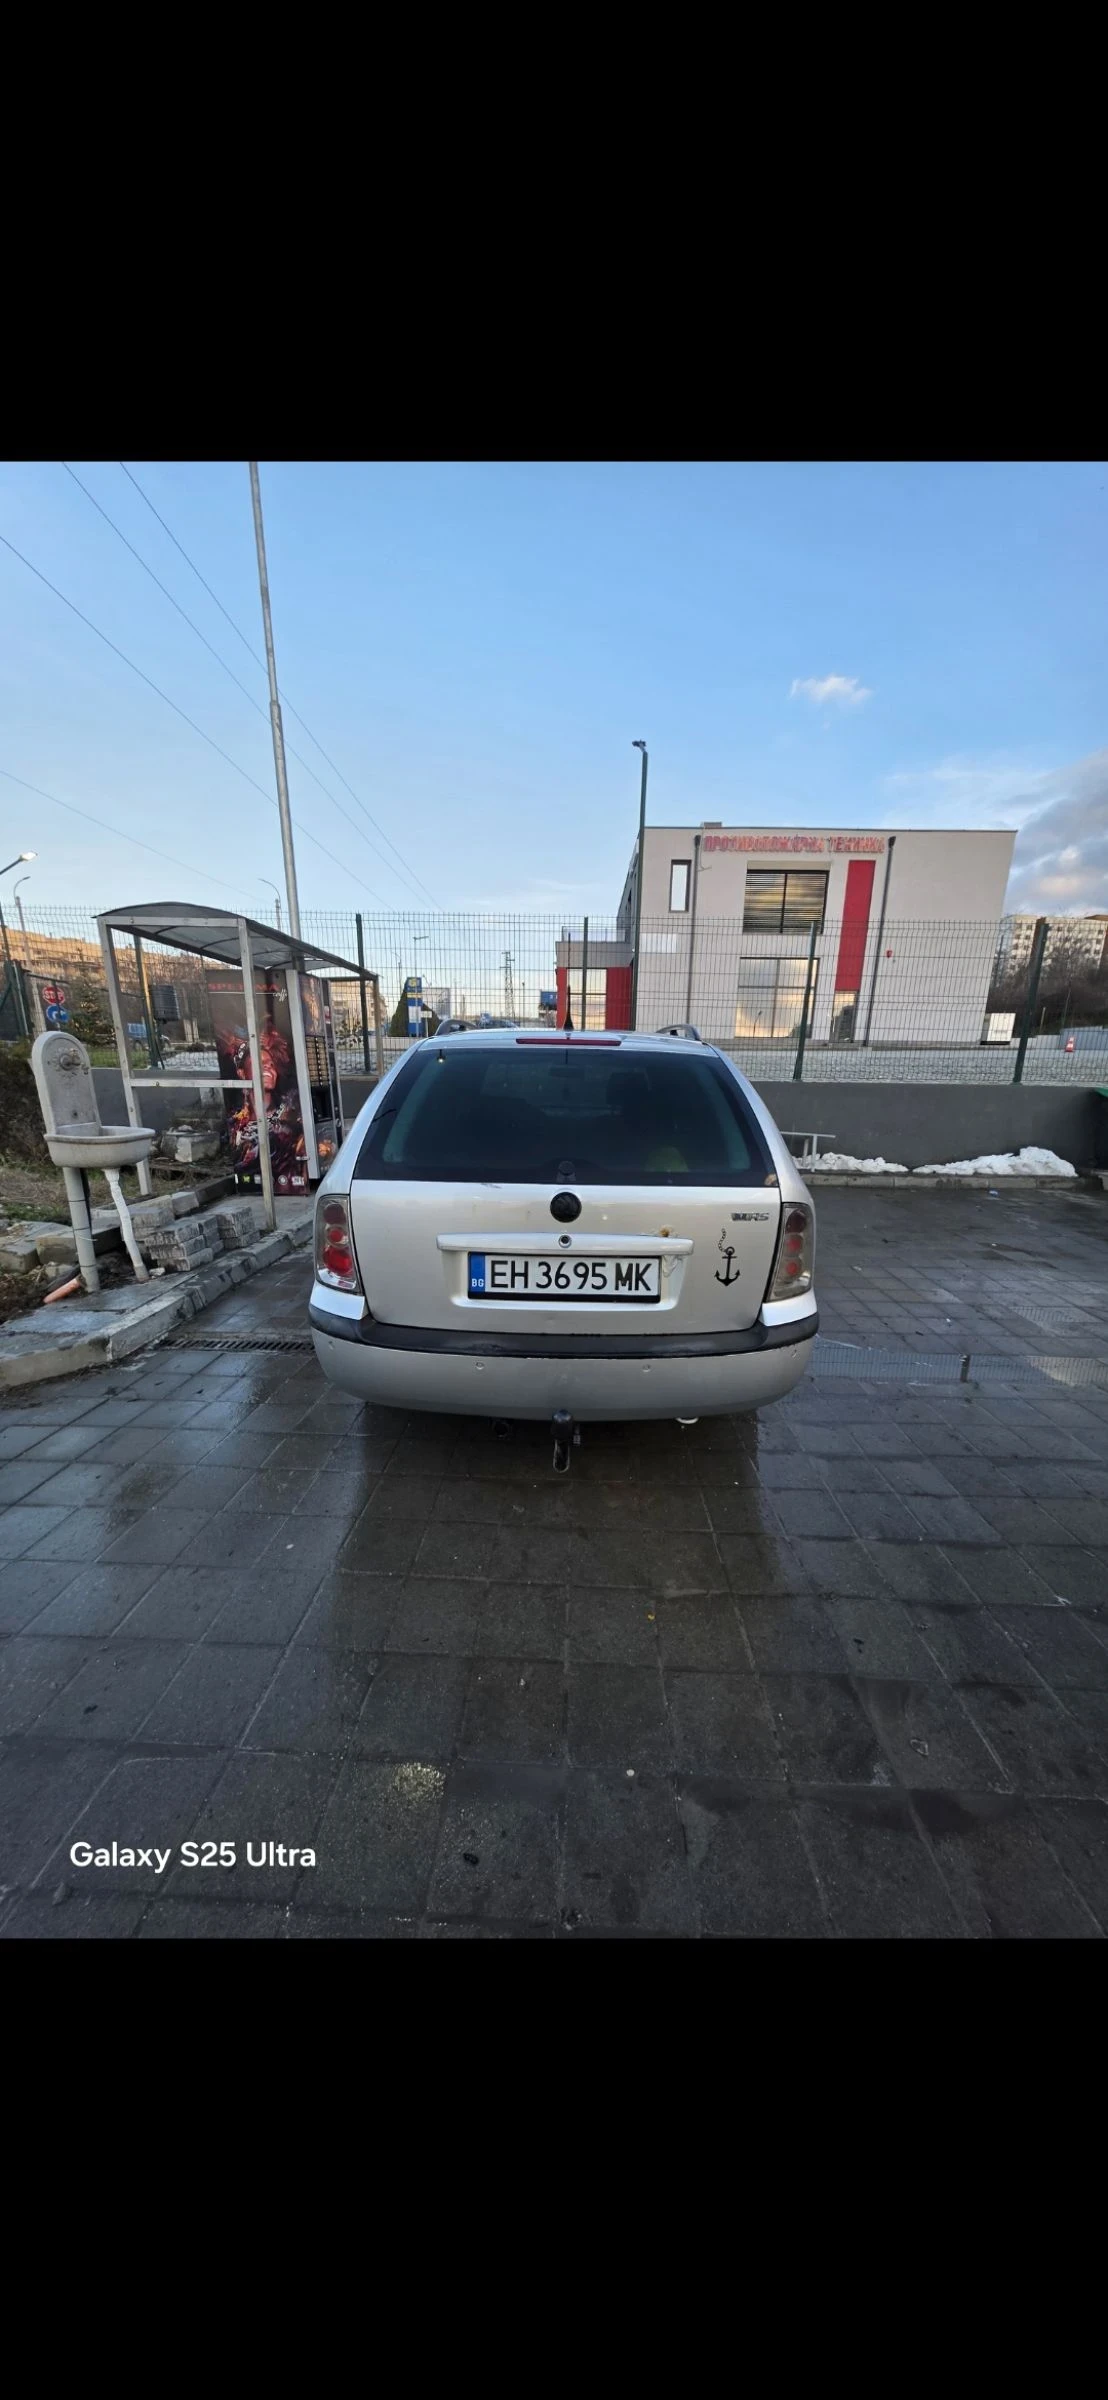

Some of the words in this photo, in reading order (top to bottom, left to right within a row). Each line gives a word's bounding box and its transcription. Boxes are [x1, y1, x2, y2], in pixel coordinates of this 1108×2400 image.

[471, 1278, 485, 1287] BG
[490, 1260, 529, 1289] EH
[535, 1261, 608, 1290] 3695
[614, 1262, 653, 1291] MK
